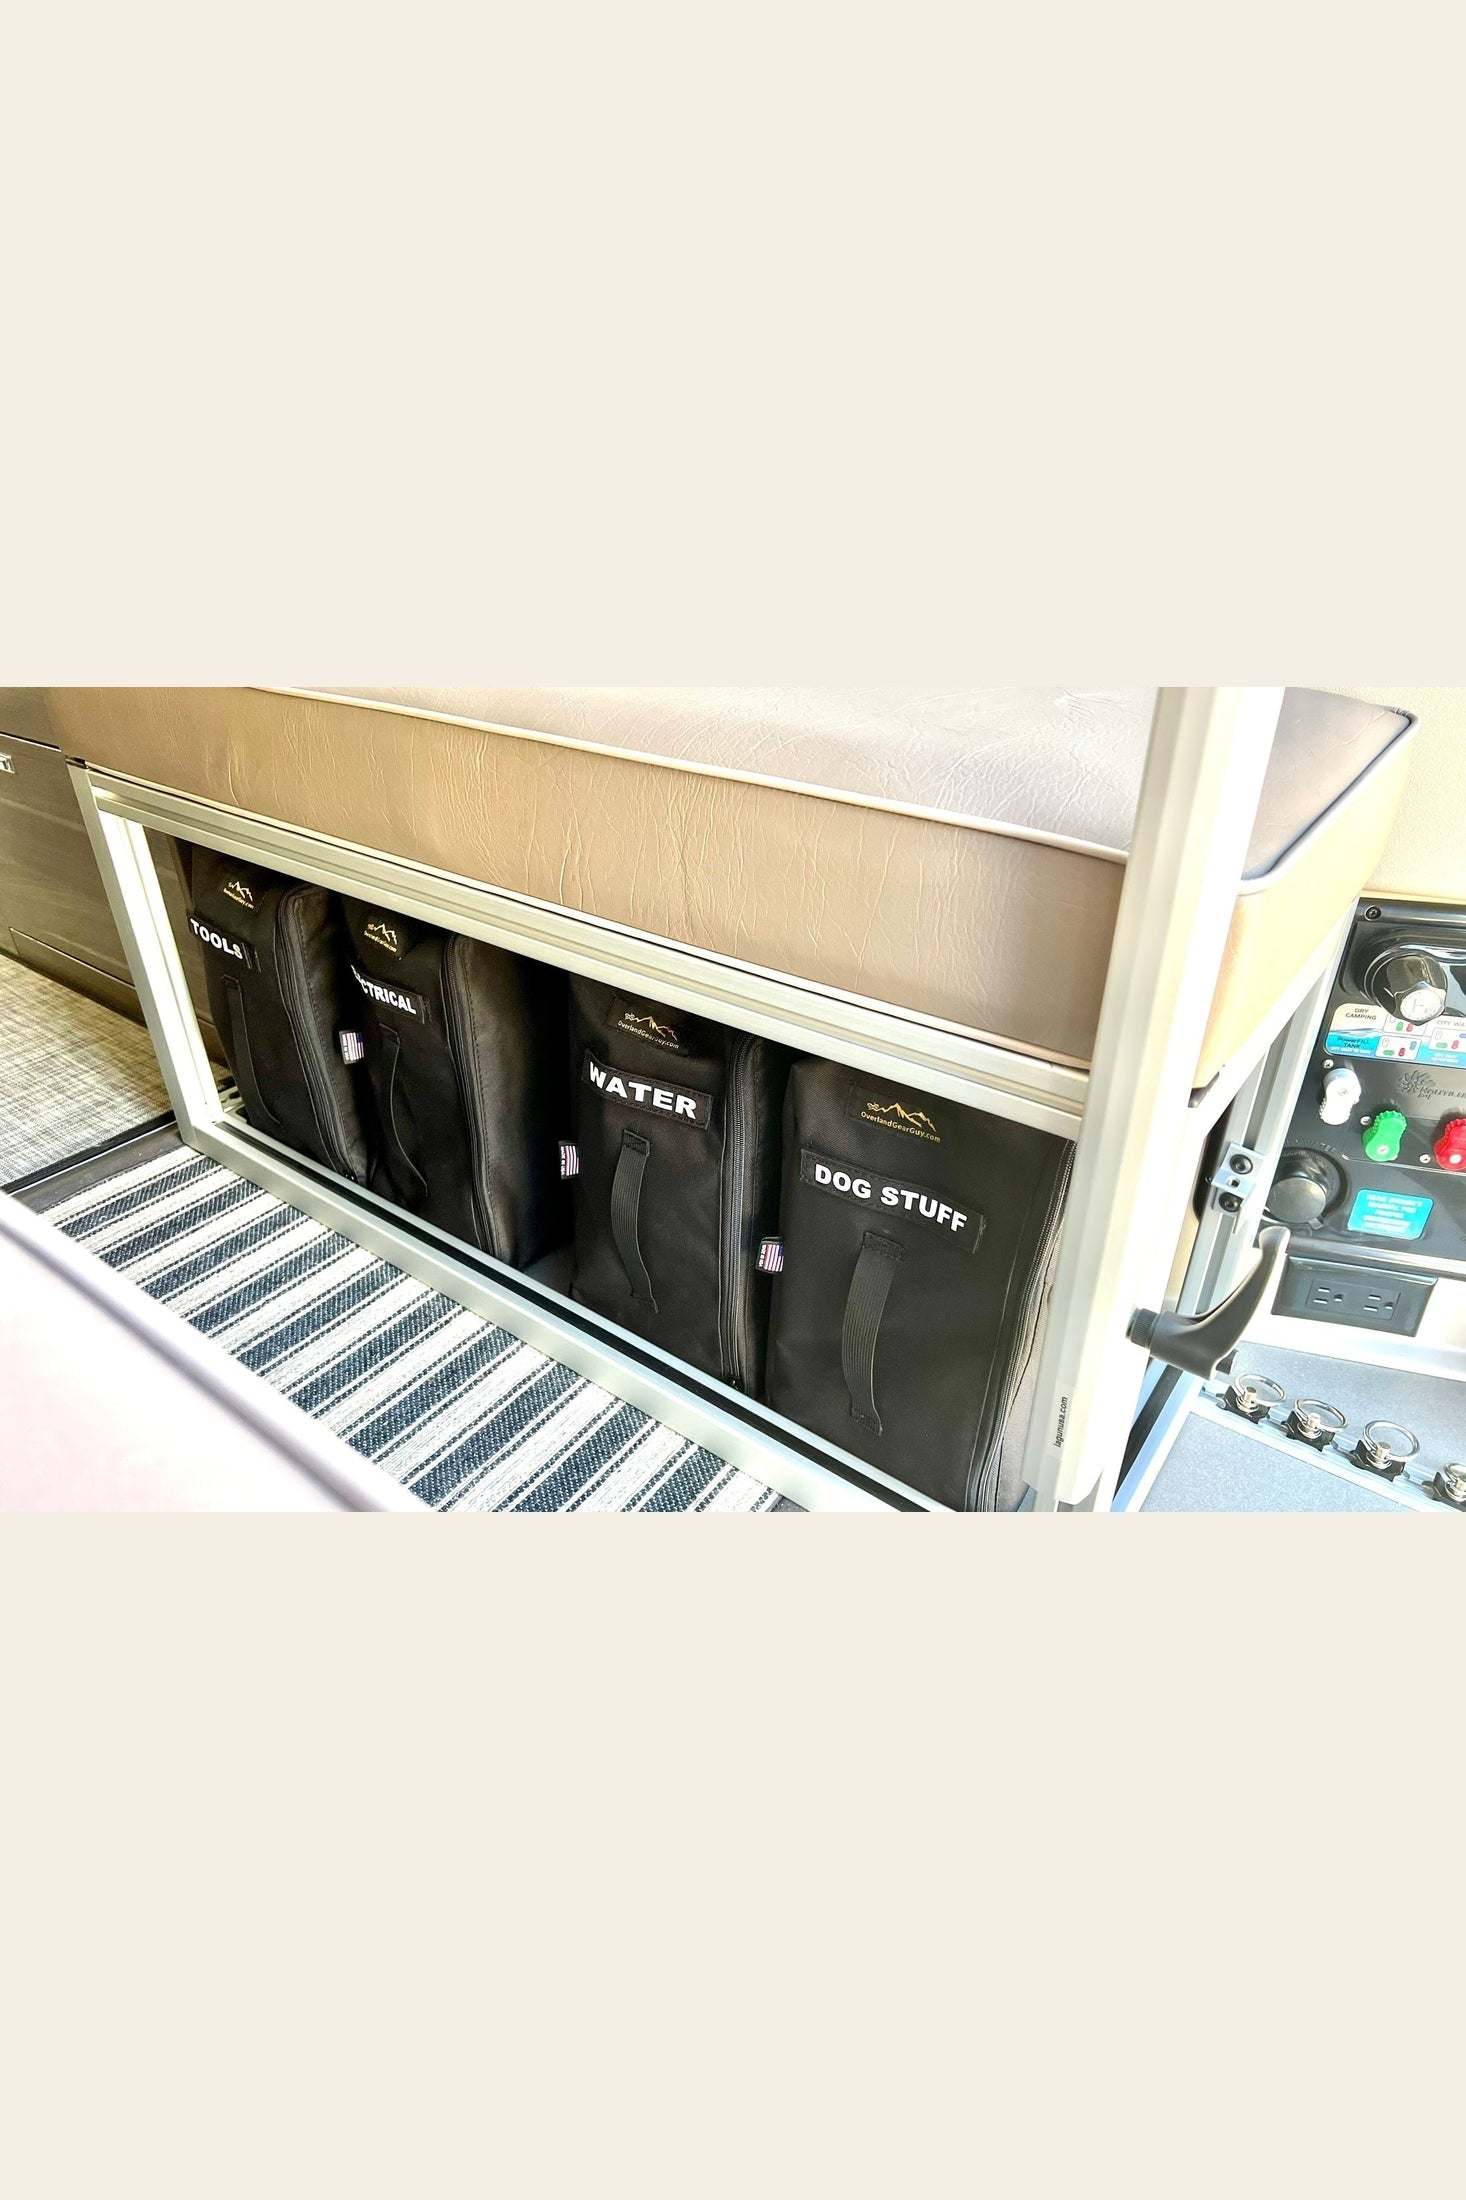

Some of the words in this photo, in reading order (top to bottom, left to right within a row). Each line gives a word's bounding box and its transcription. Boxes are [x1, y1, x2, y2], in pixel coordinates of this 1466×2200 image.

[190, 918, 243, 959] TOOLS
[350, 964, 416, 1014] CTRICAL
[590, 1061, 697, 1120] WATER
[861, 1111, 941, 1143] OverlandGearGuy.com
[815, 1164, 872, 1199] DOG
[880, 1187, 968, 1232] STUFF
